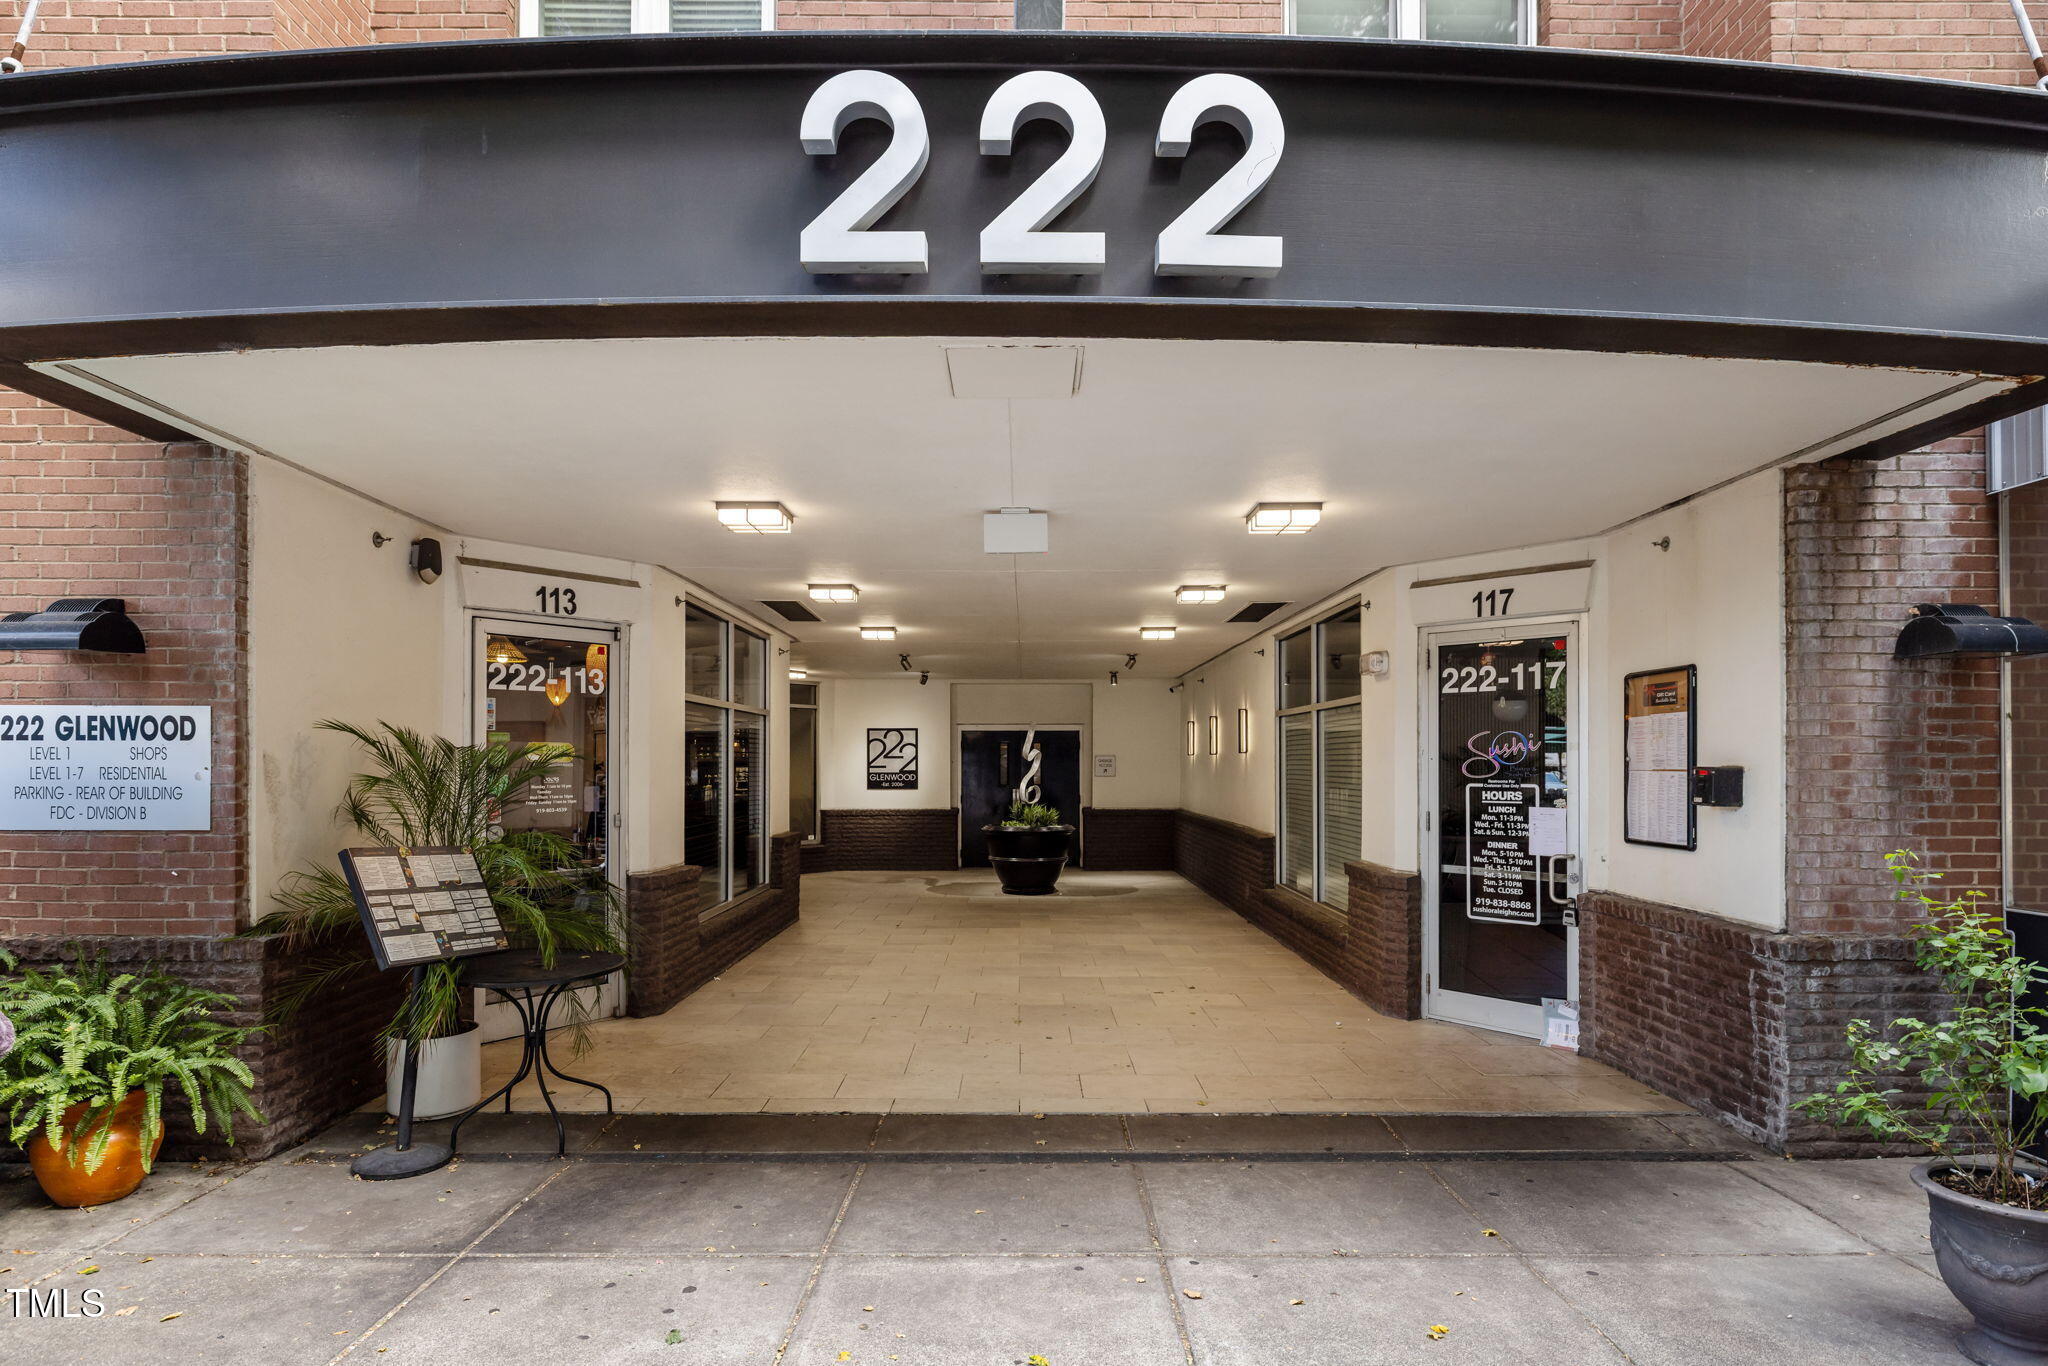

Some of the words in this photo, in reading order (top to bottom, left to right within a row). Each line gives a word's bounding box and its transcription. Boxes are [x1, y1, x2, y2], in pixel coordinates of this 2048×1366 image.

[800, 69, 1285, 277] 222
[536, 586, 577, 615] 113
[1472, 588, 1514, 617] 117
[488, 662, 605, 695] 222-113
[1442, 661, 1566, 694] 222-117
[1, 715, 44, 741] 222
[55, 715, 196, 742] GLENWOOD
[30, 747, 61, 760] LEVEL
[66, 747, 70, 760] 1
[130, 746, 167, 760] SHOPS
[867, 728, 918, 773] 222
[30, 767, 61, 780] LEVEL
[66, 767, 84, 780] 1-7
[100, 766, 167, 780] RESIDENTIAL
[869, 773, 917, 781] GLENWOOD
[14, 786, 64, 800] PARKING
[76, 786, 105, 800] REAR
[109, 786, 126, 800] OF
[130, 786, 183, 800] BUILDING
[1481, 790, 1523, 801] HOURS
[50, 806, 75, 820] FDC
[87, 806, 136, 820] DIVISION
[140, 806, 147, 820] B
[1487, 841, 1518, 849] DINNER
[1497, 887, 1524, 895] CLOSED
[1475, 897, 1531, 910] 919-838-8868
[1472, 906, 1535, 918] sushioraleighnc.com
